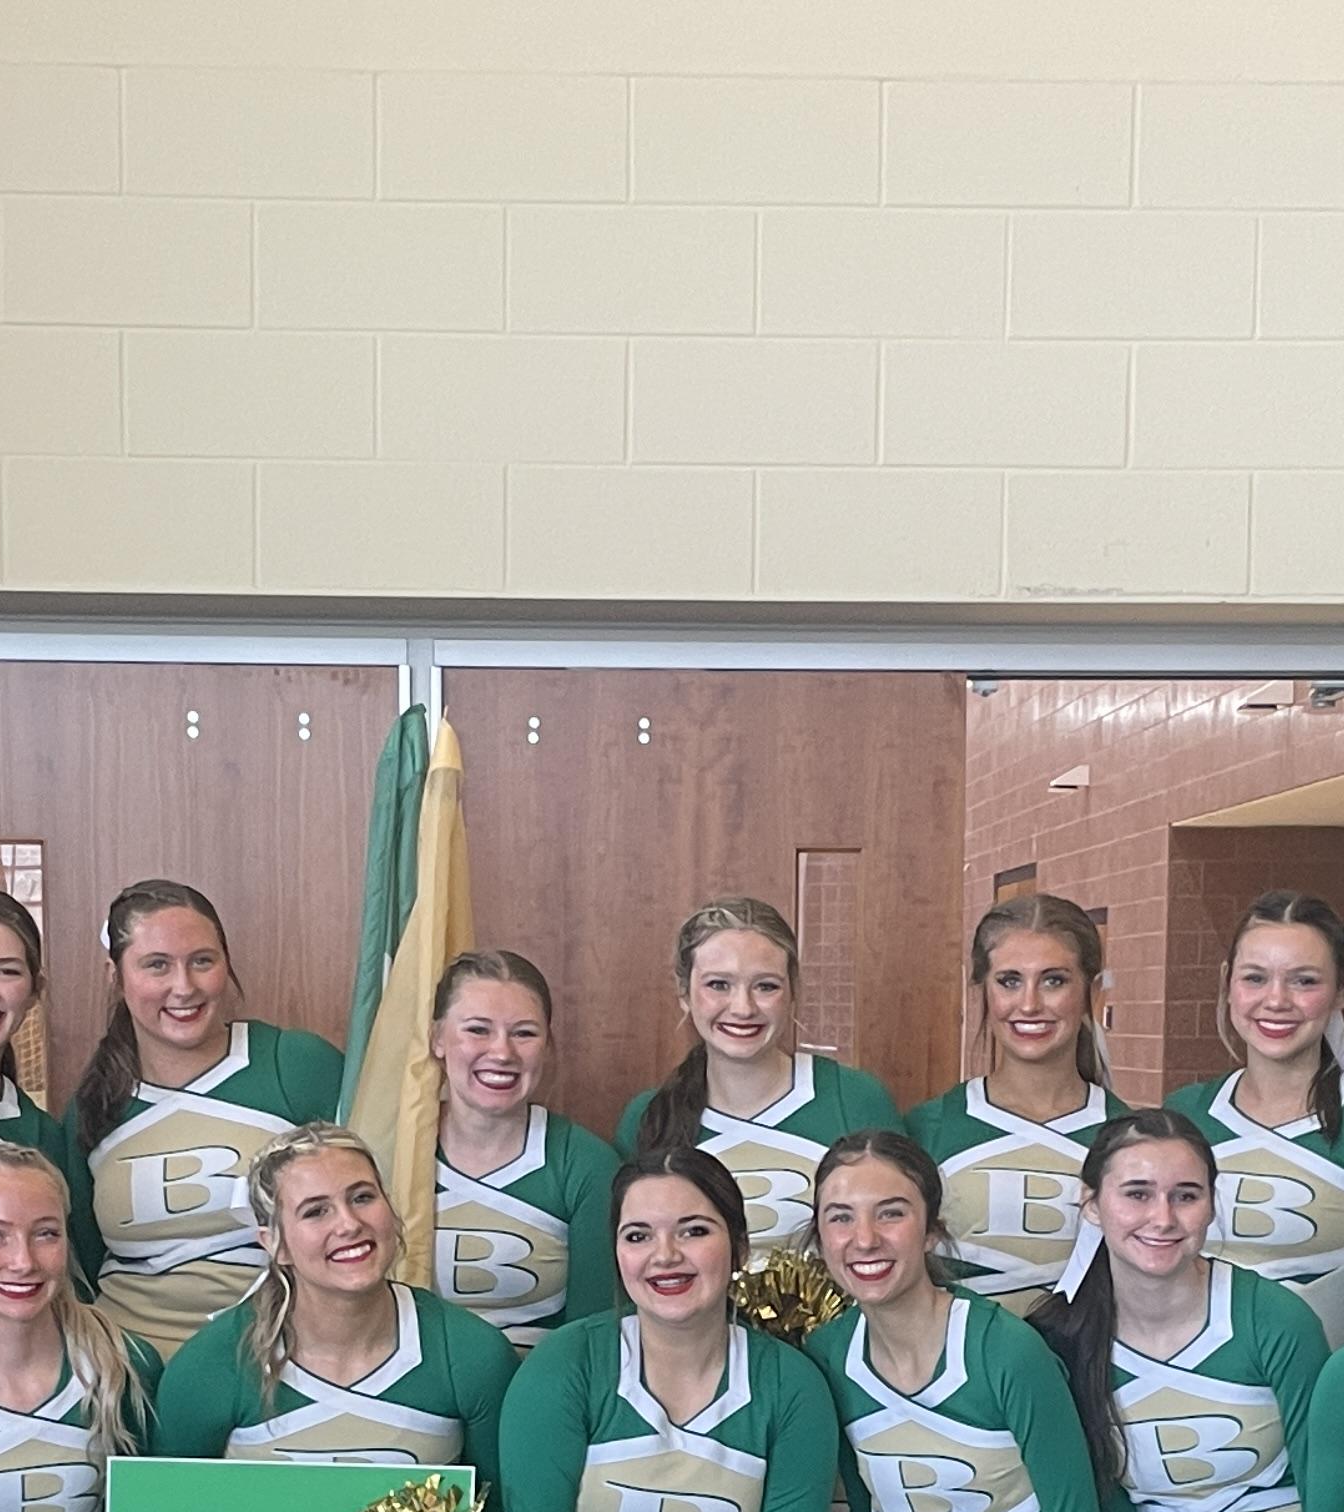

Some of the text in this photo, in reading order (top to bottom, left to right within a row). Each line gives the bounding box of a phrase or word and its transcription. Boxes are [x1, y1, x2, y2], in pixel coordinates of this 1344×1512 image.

[116, 1145, 246, 1226] B
[972, 1167, 1082, 1240] B
[1216, 1170, 1318, 1245] B
[436, 1228, 539, 1300] B
[1134, 1414, 1259, 1487] B
